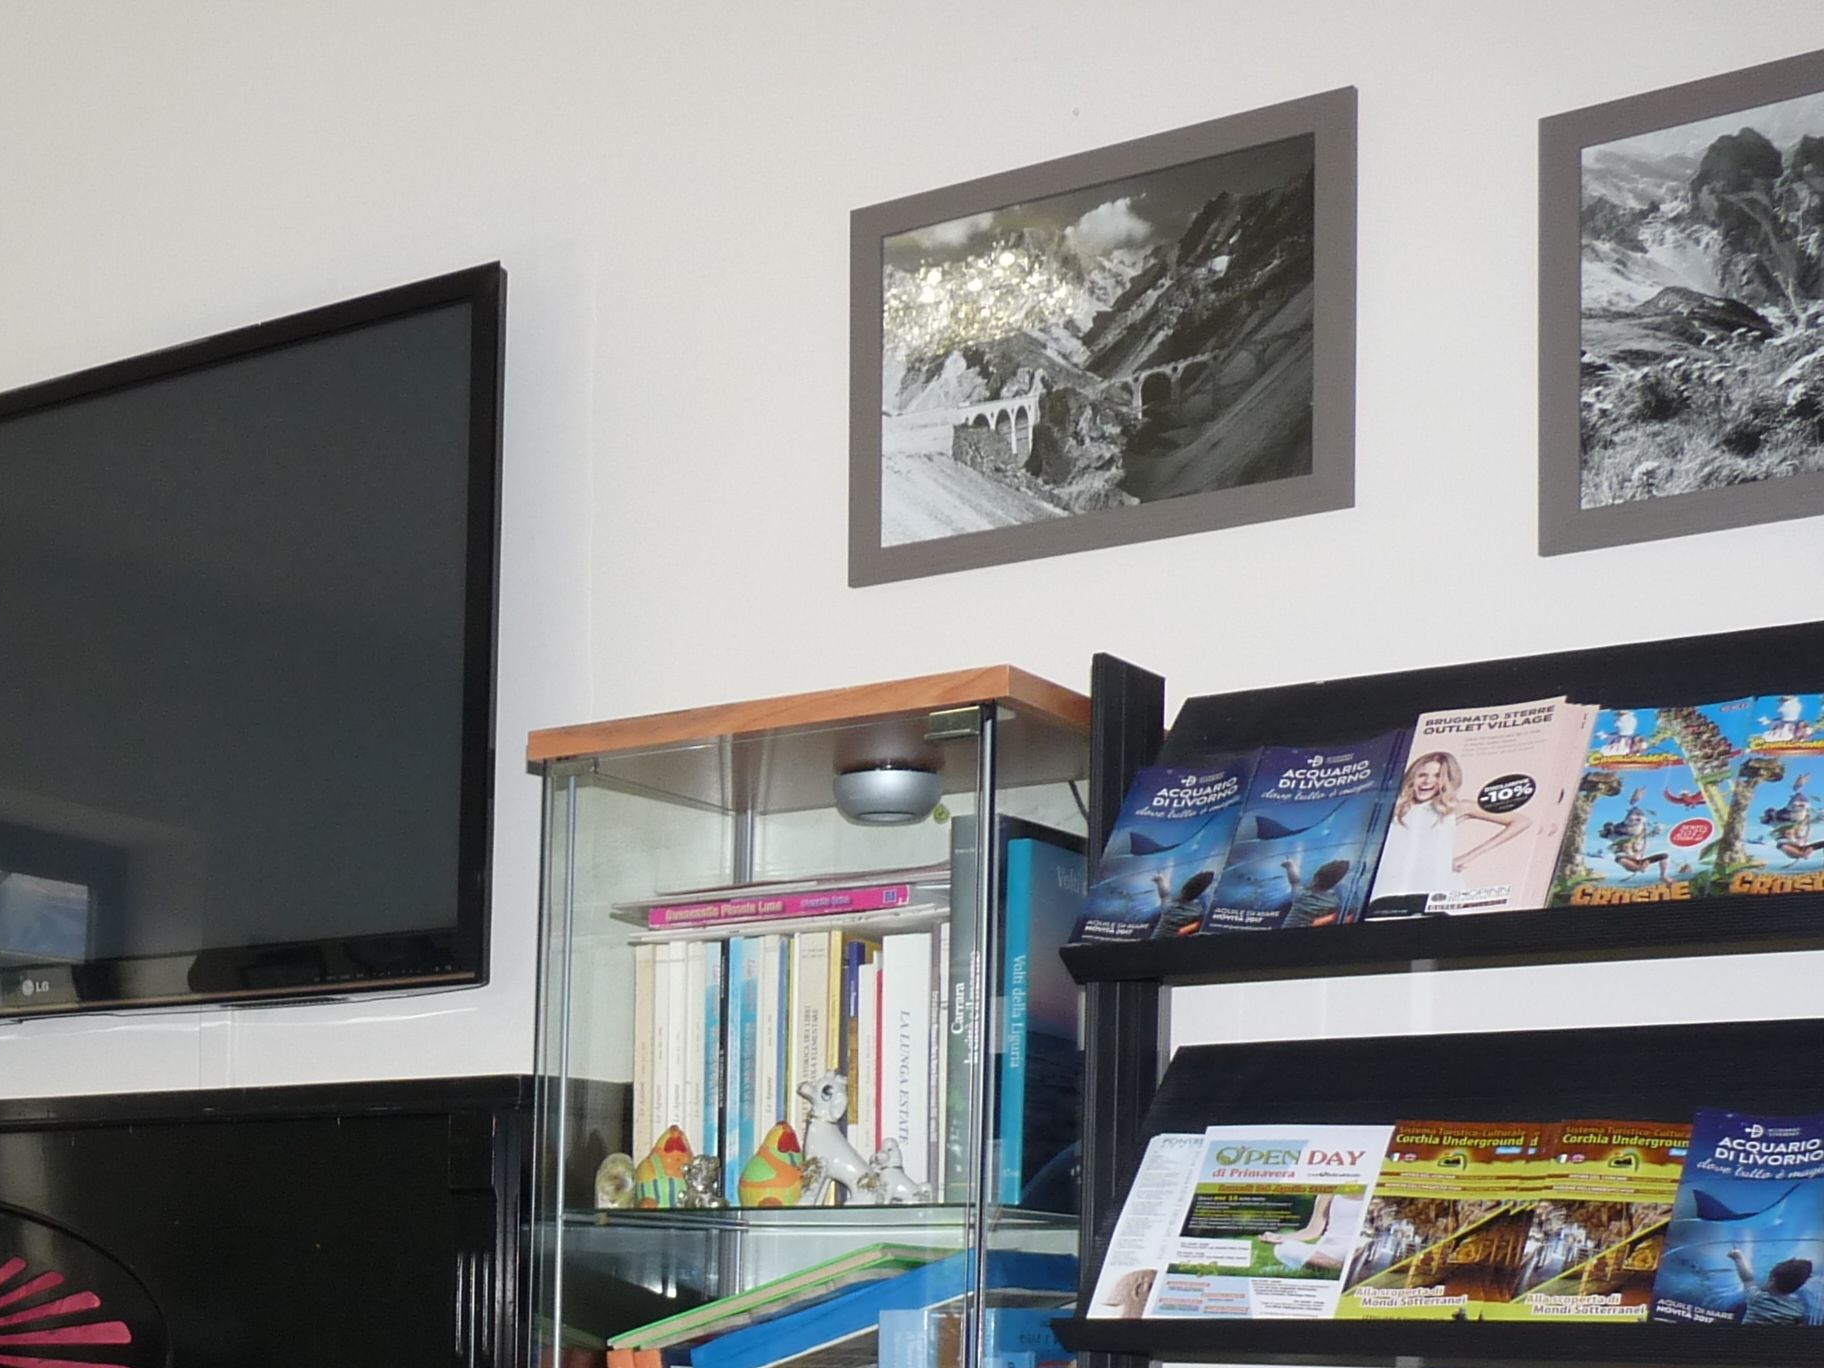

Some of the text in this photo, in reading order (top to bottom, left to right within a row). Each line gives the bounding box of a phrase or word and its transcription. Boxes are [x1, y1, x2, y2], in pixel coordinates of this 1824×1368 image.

[1424, 713, 1554, 735] OUTLET VILLAGE
[1426, 713, 1500, 727] BRUGNATO
[1283, 760, 1370, 778] ACQUARIO
[1278, 768, 1372, 789] DI LIVORNO
[1156, 776, 1238, 798] ACQUARIO
[1480, 784, 1534, 803] -10%
[1152, 784, 1239, 808] DI LIVORNO
[36, 980, 49, 992] LG
[951, 982, 966, 1034] Carrara
[1008, 954, 1026, 1068] Volti della Liguria
[898, 1009, 911, 1145] LA LUNGA ESTATE
[1399, 1126, 1526, 1138] Sistema Turistico-Culturale
[1566, 1126, 1605, 1135] Sistema
[1396, 1134, 1524, 1147] Corchia Underground
[1563, 1133, 1608, 1145] Corchia
[1718, 1136, 1822, 1155] ACQUARIO
[1217, 1145, 1366, 1166] OPEN DAY
[1715, 1147, 1736, 1160] DI
[1213, 1167, 1295, 1178] di Primavera
[1362, 1296, 1466, 1306] Mondi Sotterranei
[1534, 1304, 1645, 1315] Mondi Sotterranei
[1693, 1311, 1716, 1323] 2017
